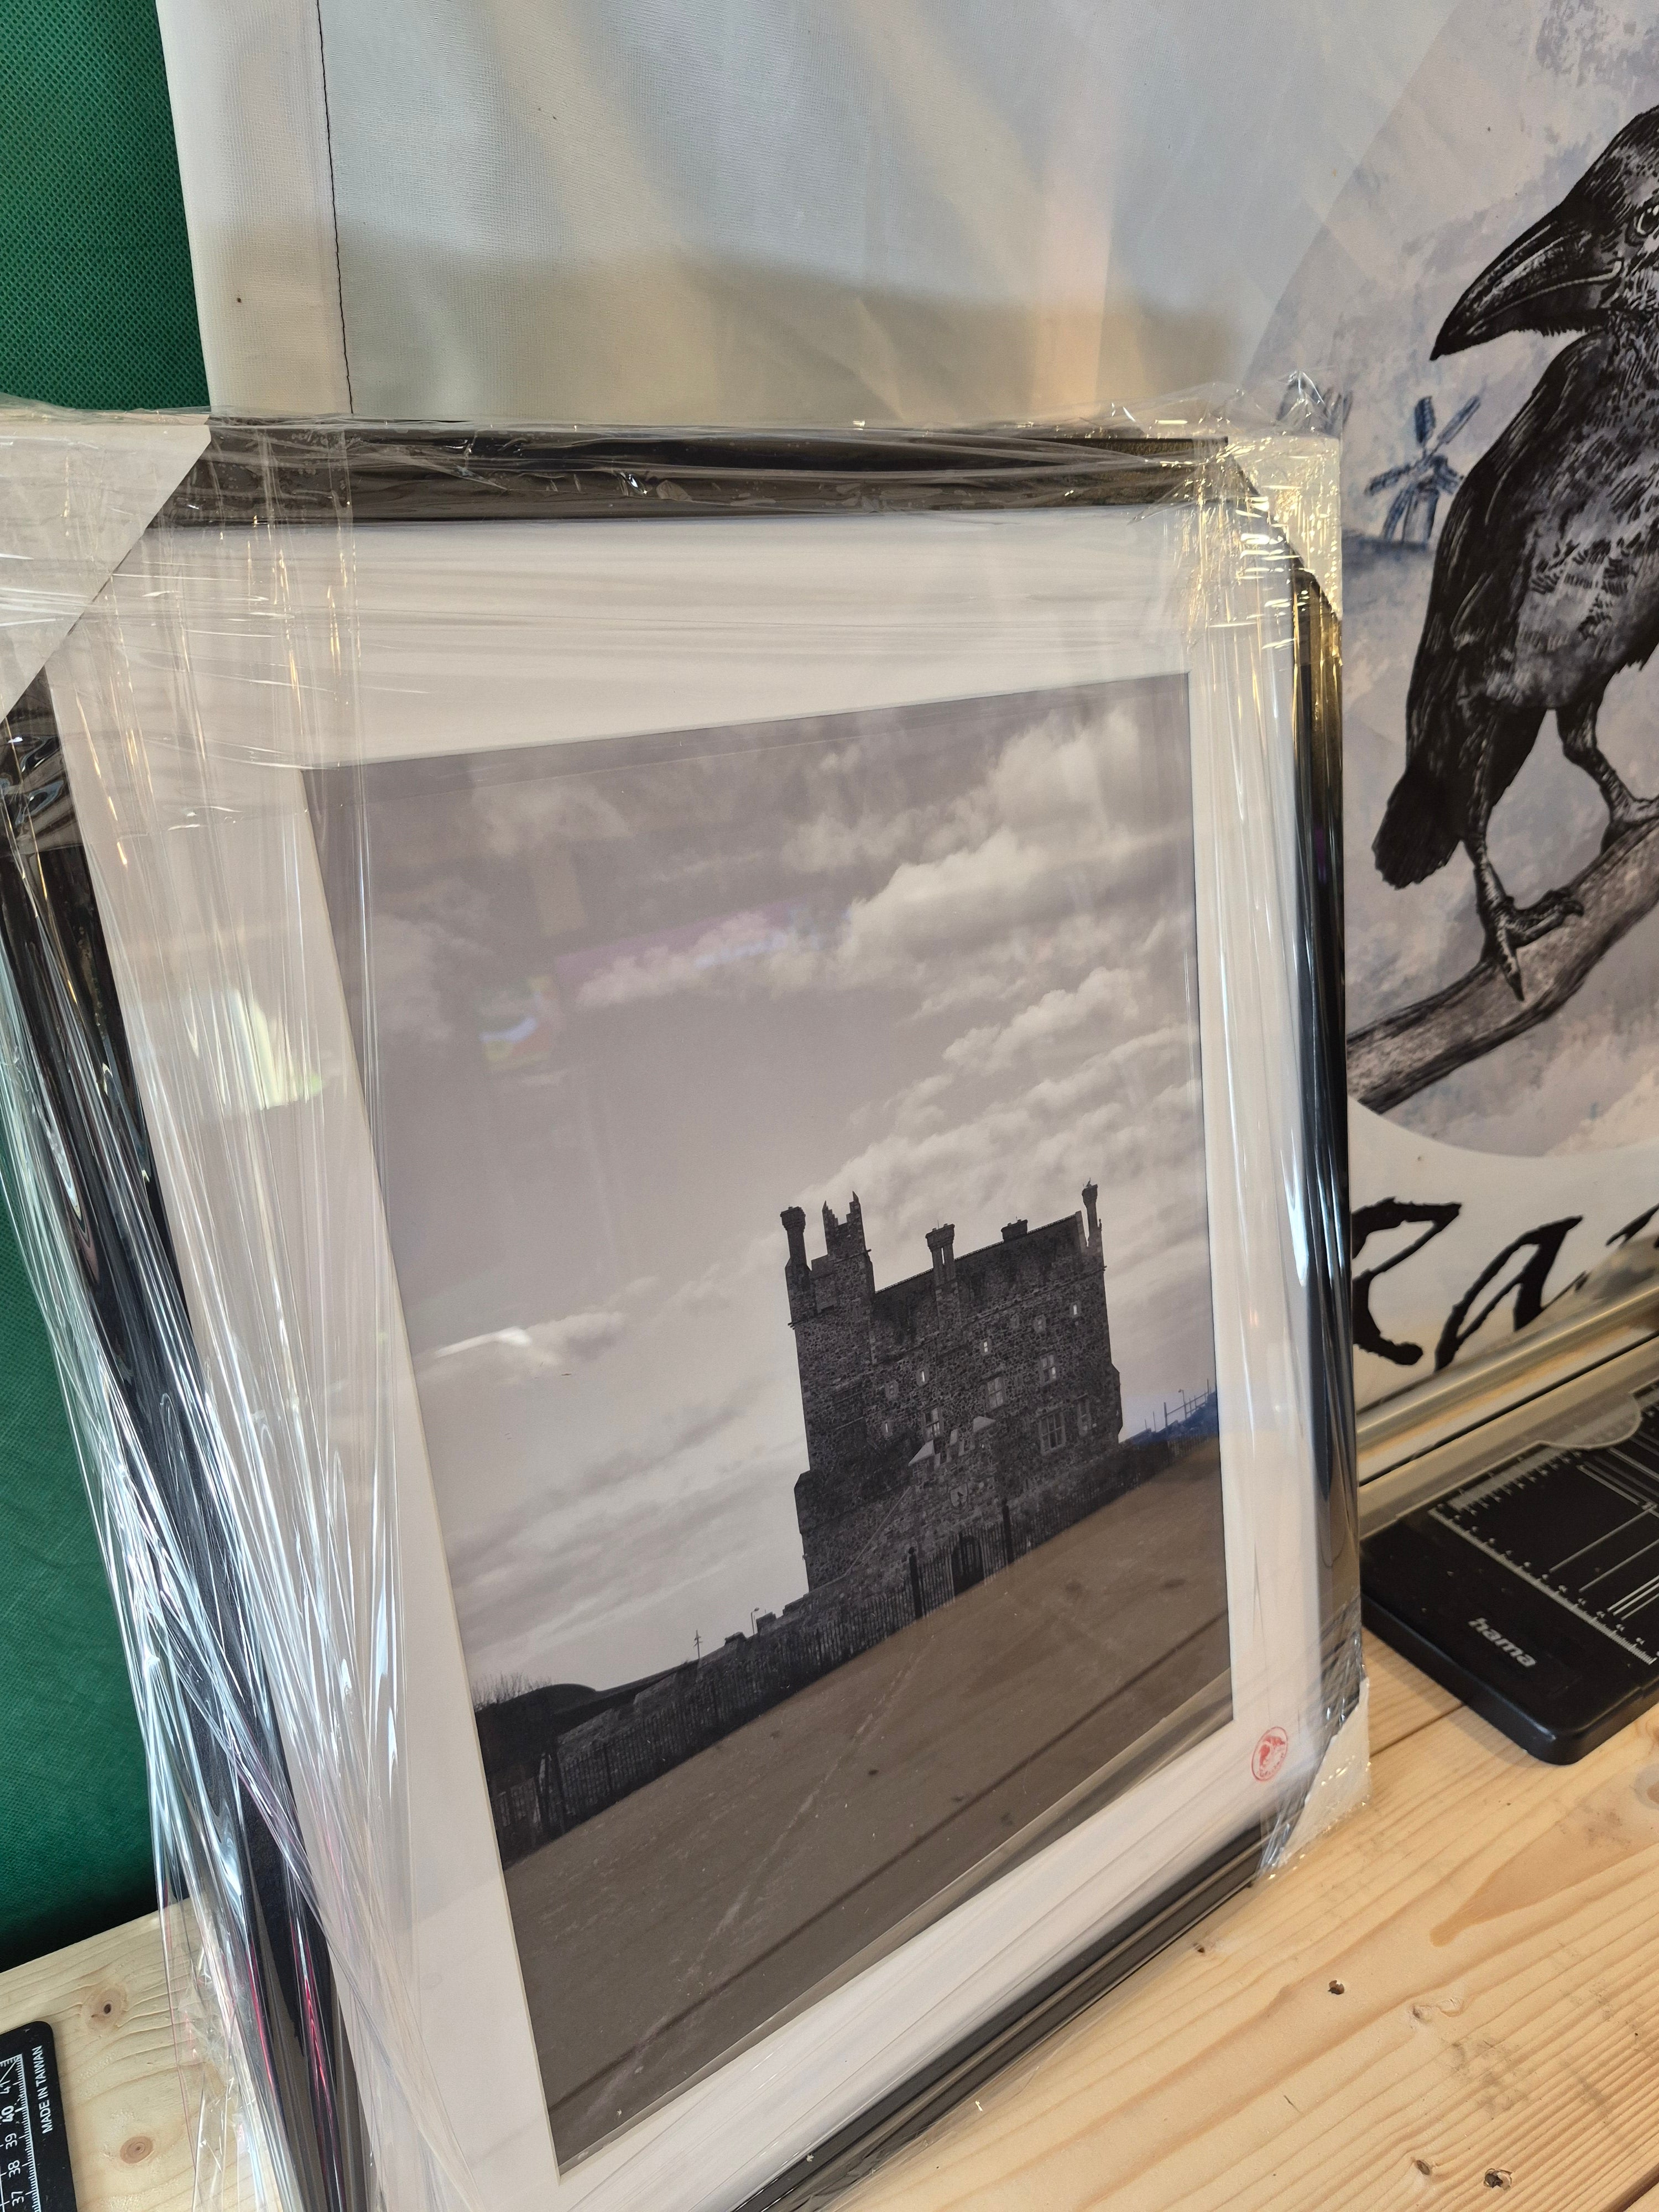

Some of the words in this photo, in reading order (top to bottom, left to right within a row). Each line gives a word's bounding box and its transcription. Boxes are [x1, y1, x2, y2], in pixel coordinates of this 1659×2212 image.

[1468, 1618, 1537, 1667] hama
[32, 2045, 48, 2087] TAIWAN
[37, 2086, 49, 2100] IN
[1, 2105, 15, 2122] 40
[39, 2099, 53, 2134] MADE
[4, 2133, 18, 2150] 39
[8, 2159, 21, 2178] 38
[11, 2191, 24, 2206] 37
